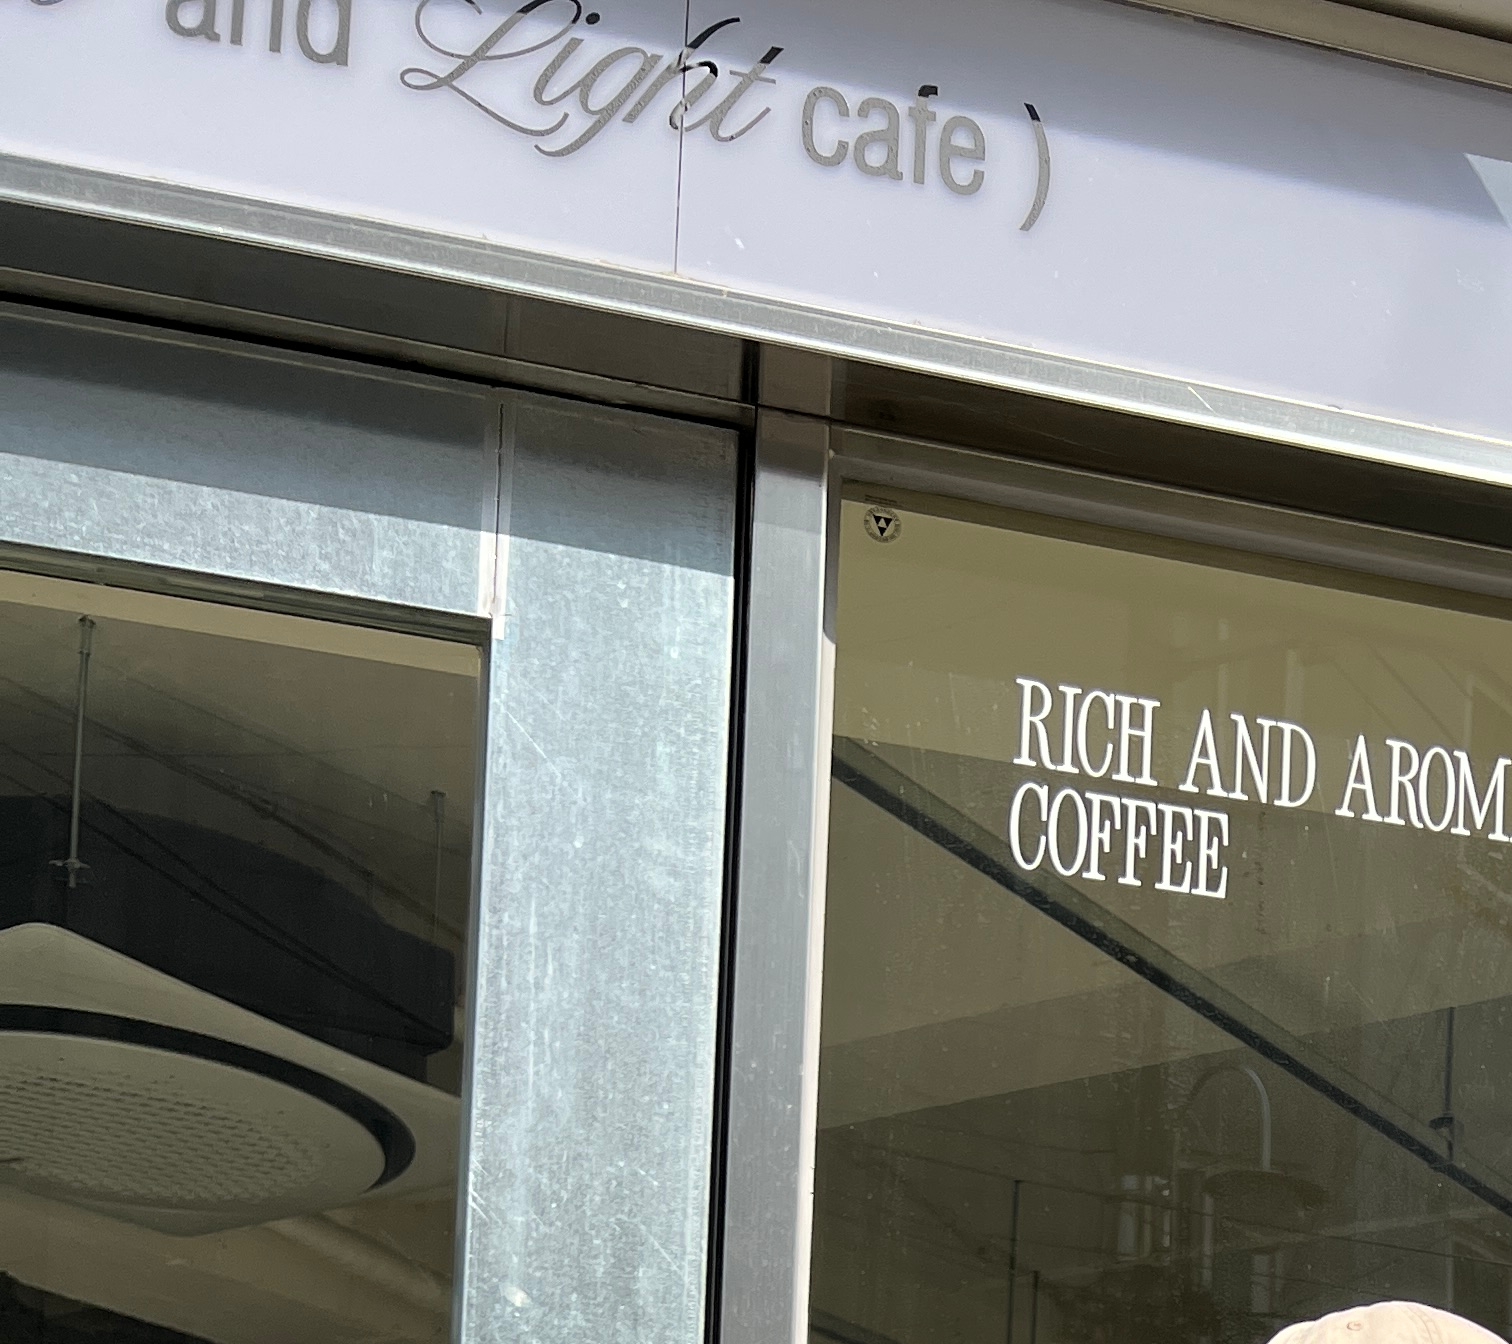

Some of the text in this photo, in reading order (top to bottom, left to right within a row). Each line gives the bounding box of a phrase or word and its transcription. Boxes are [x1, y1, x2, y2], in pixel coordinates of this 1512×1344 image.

[400, 0, 783, 158] Light
[801, 84, 986, 196] cafe
[1014, 678, 1160, 787] RICH
[1179, 709, 1316, 808] AND
[1010, 782, 1229, 899] COFFEE
